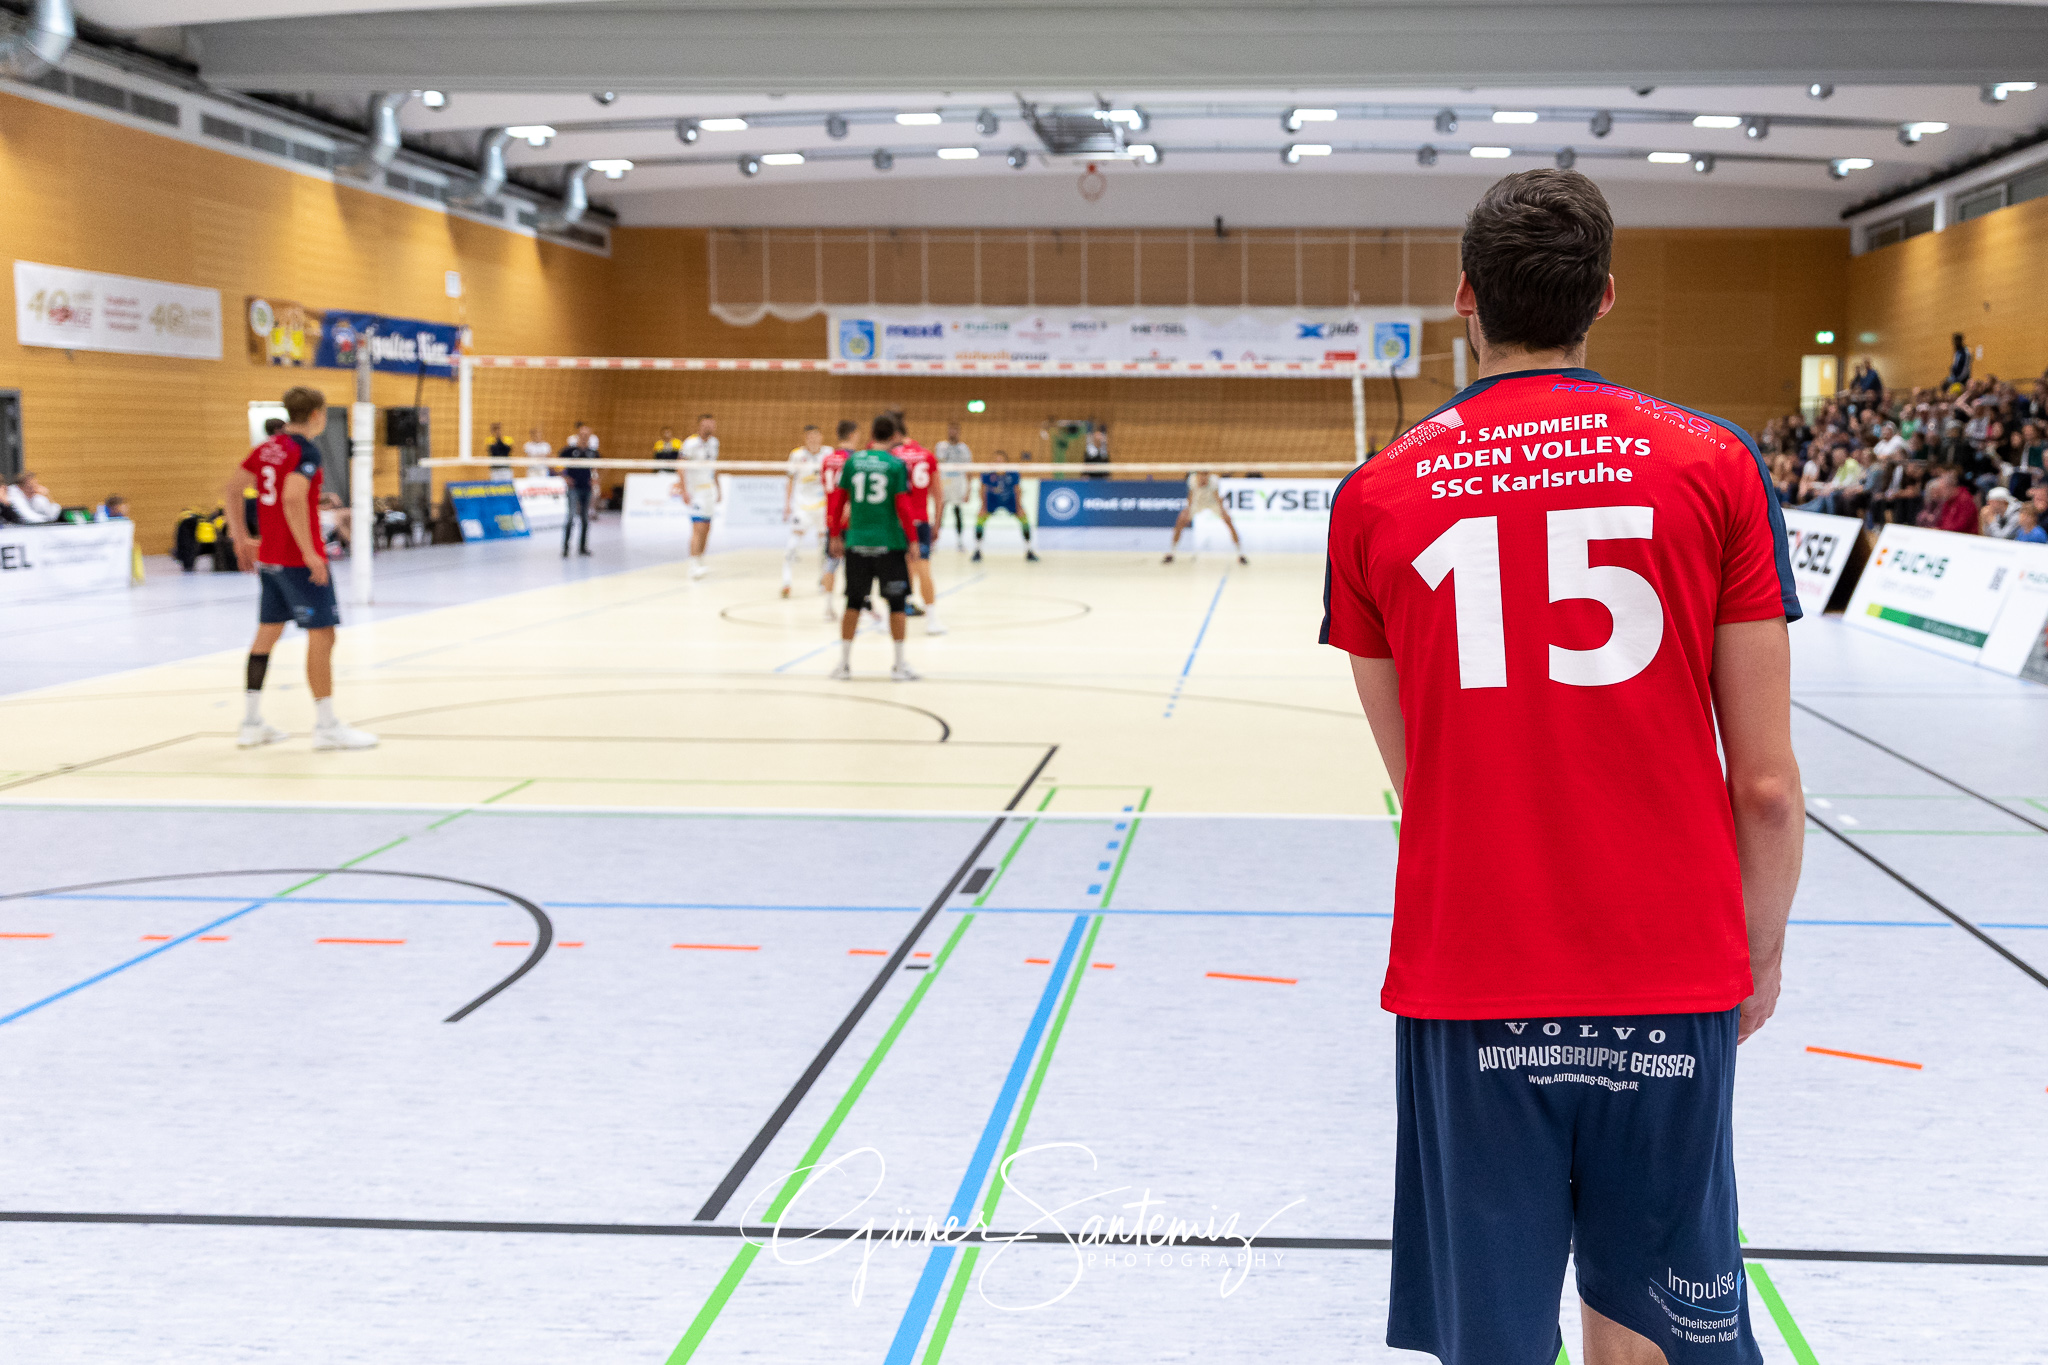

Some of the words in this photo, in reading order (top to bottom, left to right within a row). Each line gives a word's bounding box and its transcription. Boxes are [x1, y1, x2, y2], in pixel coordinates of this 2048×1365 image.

[1552, 384, 1711, 432] ROSSWAG
[1417, 426, 1447, 447] STUDIO
[1457, 430, 1472, 444] J.
[1478, 413, 1608, 442] SANDMEIER
[1634, 405, 1727, 450] engineering
[1416, 446, 1512, 478] BADEN
[1521, 436, 1651, 462] VOLLEYS
[260, 465, 277, 506] 3
[851, 471, 888, 504] 13
[912, 461, 931, 489] 6
[1431, 476, 1483, 499] SSC
[1492, 462, 1633, 493] Karlsruhe
[0, 545, 33, 570] EL
[1890, 551, 1950, 578] FUCHS
[1411, 506, 1664, 689] 15
[1505, 1022, 1666, 1043] VOLVO
[1478, 1045, 1628, 1072] AUTOHAUSGRUPPE
[1630, 1052, 1696, 1078] GEISSER
[1648, 1286, 1661, 1304] Das
[1668, 1267, 1735, 1303] Impulse
[1671, 1325, 1683, 1338] am
[1685, 1331, 1716, 1344] Neuen
